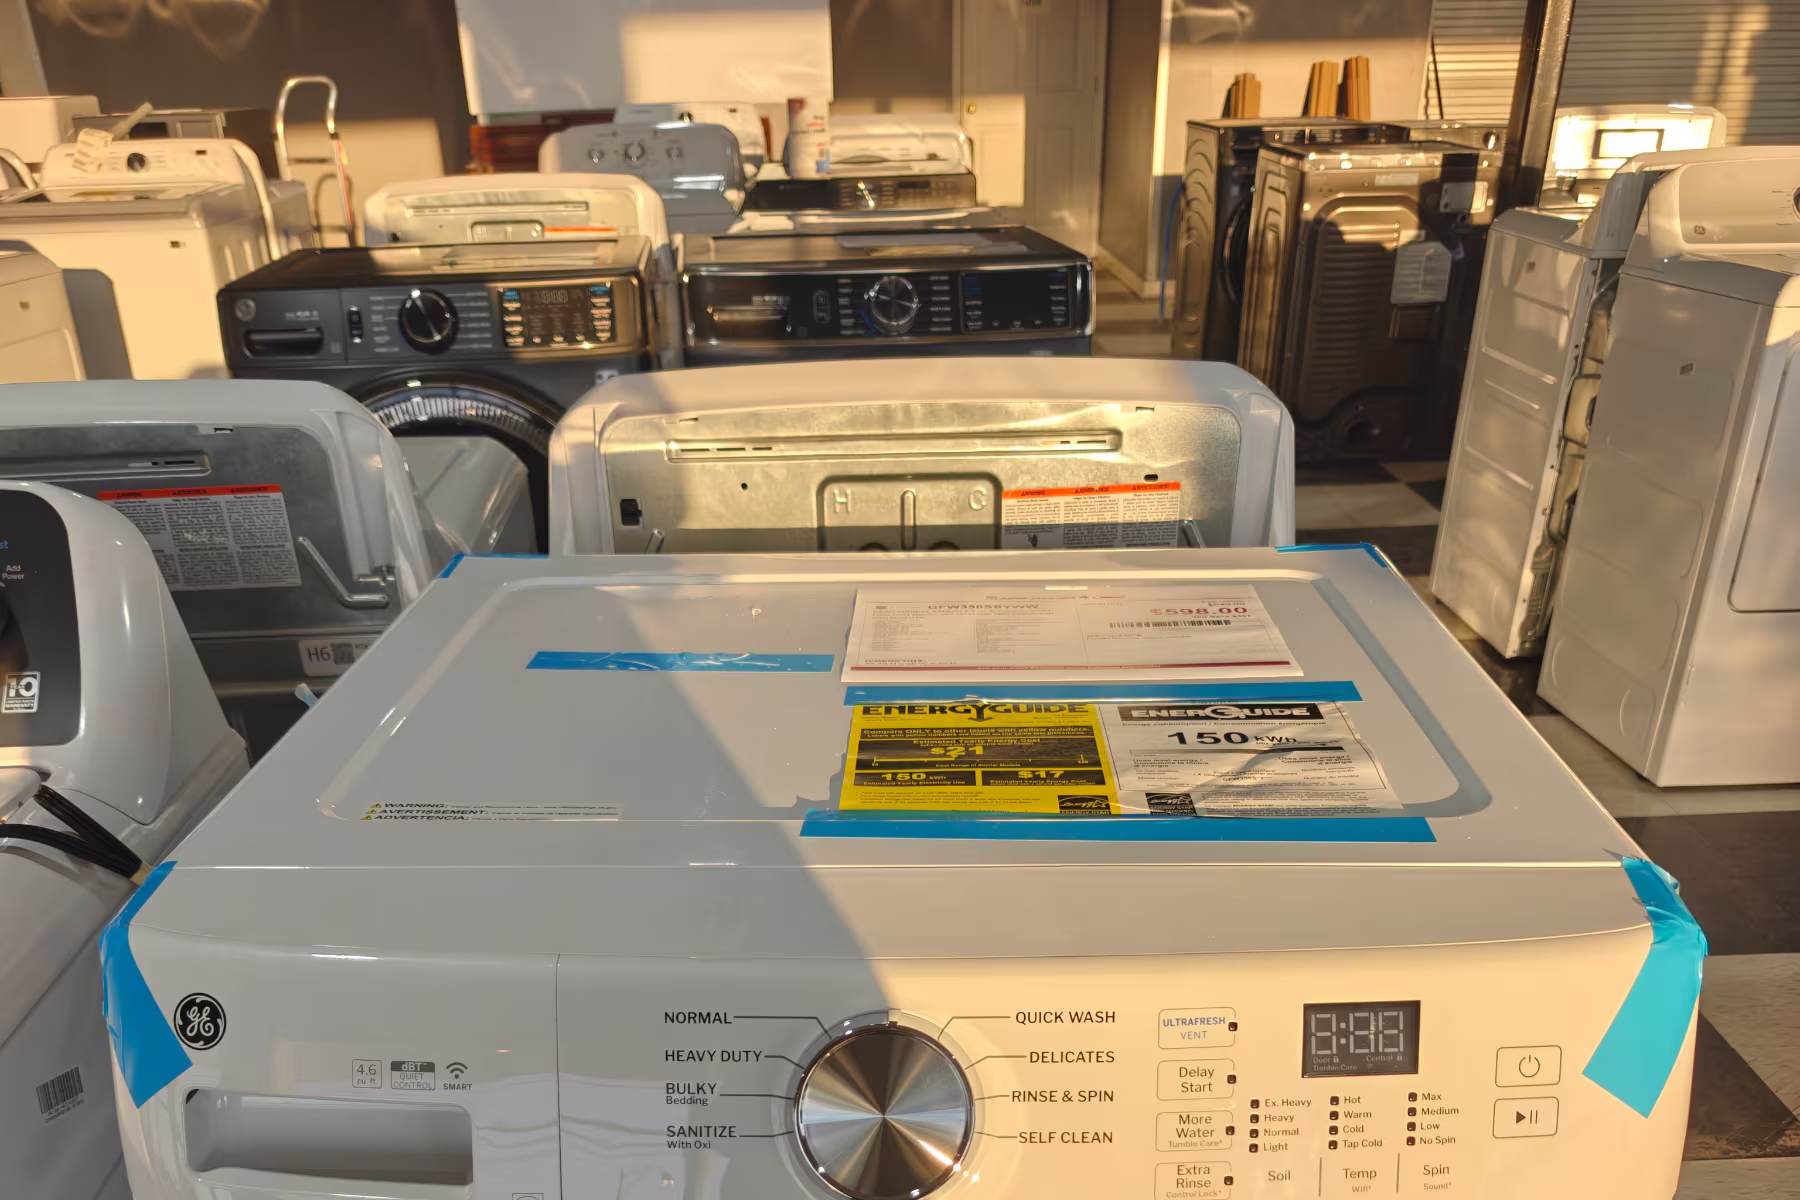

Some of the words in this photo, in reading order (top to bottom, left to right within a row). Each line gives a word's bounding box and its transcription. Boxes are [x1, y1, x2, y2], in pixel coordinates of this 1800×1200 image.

[834, 488, 851, 513] H
[1149, 607, 1249, 616] $598.00
[1167, 731, 1249, 745] 150
[1253, 735, 1297, 743] kWh
[930, 746, 984, 756] $21
[881, 772, 927, 781] 150
[1017, 770, 1065, 780] $17
[664, 1011, 733, 1024] NORMAL
[1015, 1011, 1065, 1025] QUICK
[1068, 1011, 1116, 1024] WASH
[1162, 1016, 1226, 1027] ULTRAFRESH
[1180, 1030, 1208, 1040] VENT
[665, 1049, 717, 1062] HEAVY
[720, 1050, 763, 1063] DUTY
[1029, 1051, 1115, 1064] DELICATES
[1312, 1056, 1331, 1064] Door
[1366, 1054, 1393, 1063] Control
[356, 1063, 377, 1076] 4.6
[1178, 1066, 1215, 1079] Delay
[1312, 1064, 1339, 1072] Tumble
[1340, 1064, 1358, 1072] Care
[356, 1078, 369, 1086] cu.
[399, 1072, 425, 1081] QUIET
[392, 1081, 433, 1091] CONTROL
[443, 1083, 473, 1091] SMART
[666, 1082, 717, 1095] BULKY
[1180, 1081, 1213, 1093] Start
[666, 1096, 709, 1107] Bedding
[1011, 1090, 1058, 1103] RINSE
[1061, 1090, 1074, 1103] &
[1077, 1090, 1114, 1103] SPIN
[1343, 1095, 1361, 1105] Hot
[1421, 1092, 1442, 1101] Max
[1264, 1099, 1280, 1107] Ex.
[1281, 1098, 1312, 1108] Heavy
[1343, 1110, 1372, 1119] Warm
[1421, 1106, 1460, 1116] Medium
[1178, 1114, 1213, 1125] More
[1264, 1113, 1295, 1123] Heavy
[666, 1125, 737, 1138] SANITIZE
[1263, 1127, 1300, 1136] Normal
[1342, 1124, 1365, 1134] Cold
[1420, 1121, 1441, 1131] Low
[1018, 1131, 1057, 1144] SELF
[1060, 1131, 1113, 1144] CLEAN
[1175, 1127, 1216, 1139] Water
[667, 1140, 692, 1149] With
[693, 1140, 711, 1149] Oxi
[1168, 1140, 1198, 1148] Tumble
[1342, 1139, 1359, 1149] Tap
[1361, 1138, 1383, 1148] Cold
[1419, 1136, 1434, 1145] No
[1435, 1135, 1456, 1147] Spin
[1263, 1142, 1289, 1153] Light
[1176, 1164, 1211, 1176] Extra
[1342, 1167, 1378, 1181] Temp
[1422, 1164, 1450, 1177] Spin
[1267, 1170, 1292, 1182] Soil
[1175, 1177, 1212, 1189] Rinse
[1165, 1191, 1198, 1199] Control
